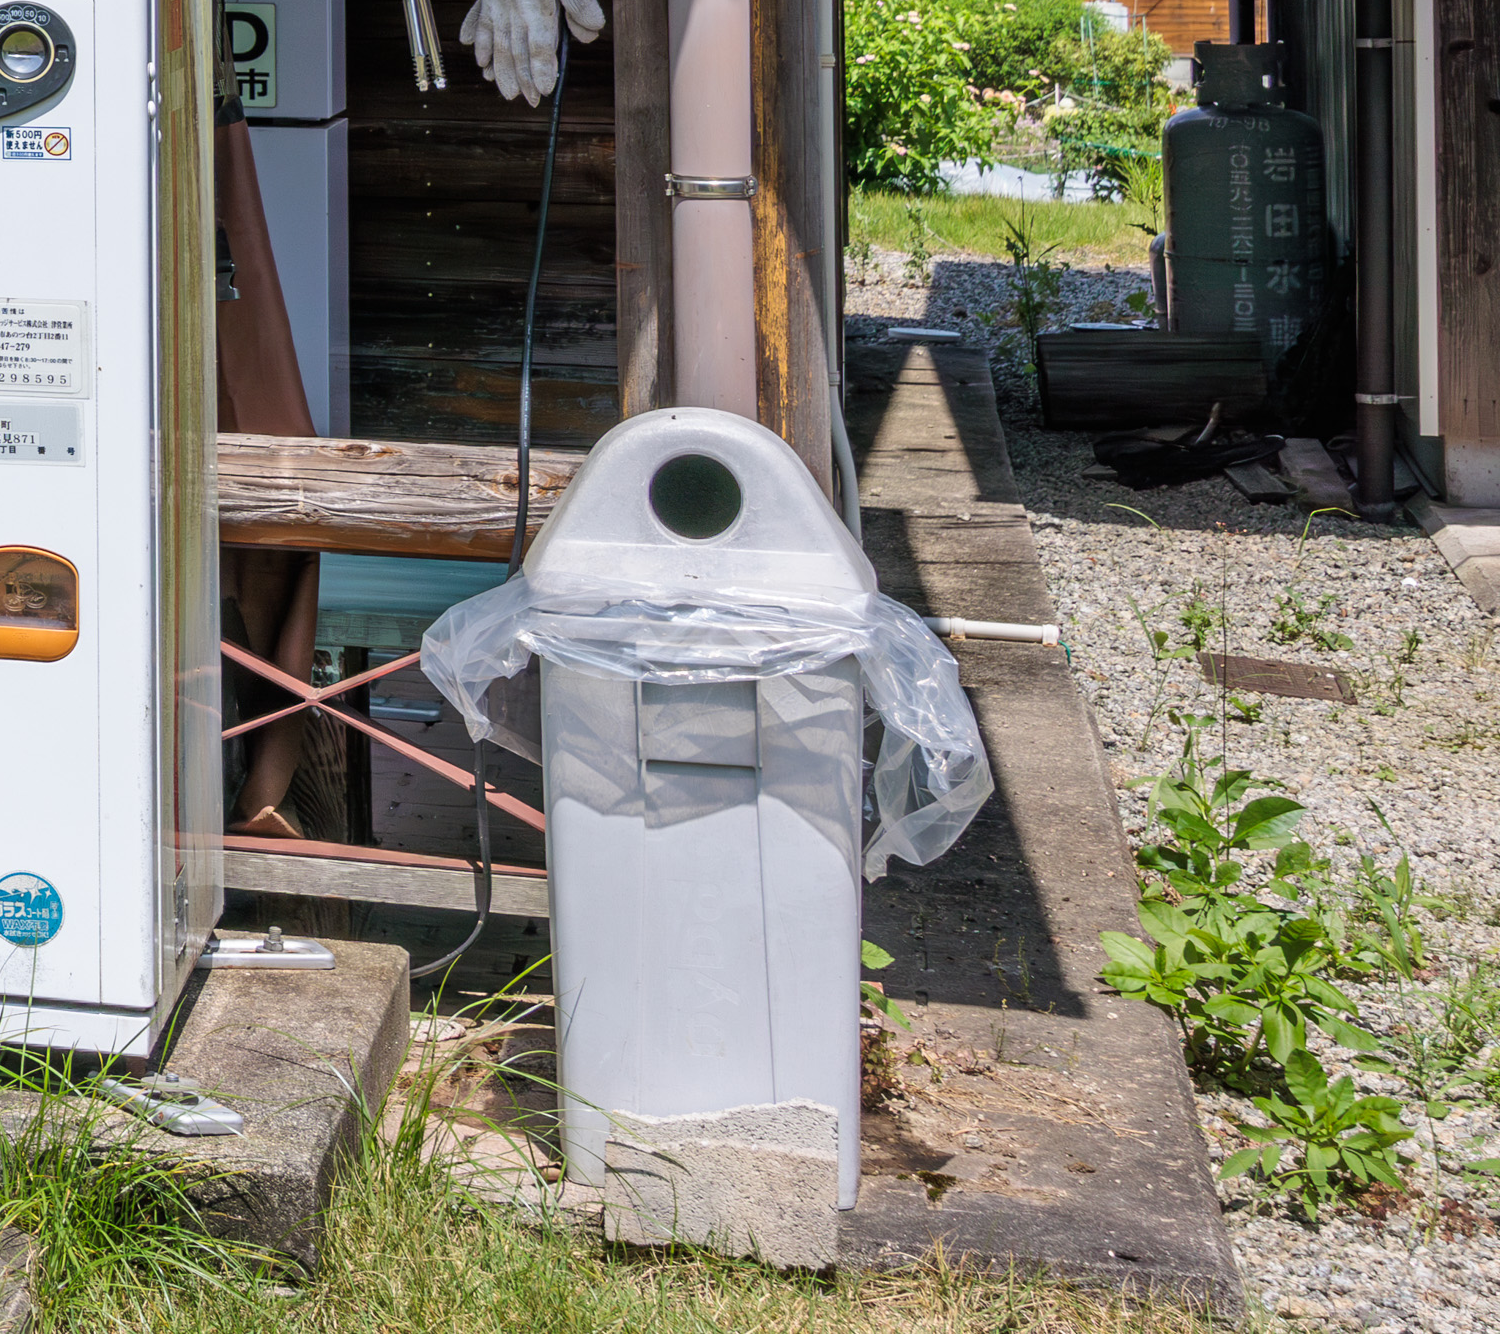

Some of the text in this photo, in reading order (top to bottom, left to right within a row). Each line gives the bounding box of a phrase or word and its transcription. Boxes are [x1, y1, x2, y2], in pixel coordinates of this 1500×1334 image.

[10, 9, 22, 18] 100
[25, 9, 35, 18] 50
[38, 14, 47, 23] 10
[6, 130, 42, 139] 新500円
[6, 140, 43, 150] 使えません
[0, 445, 75, 455] 丁目 番 号
